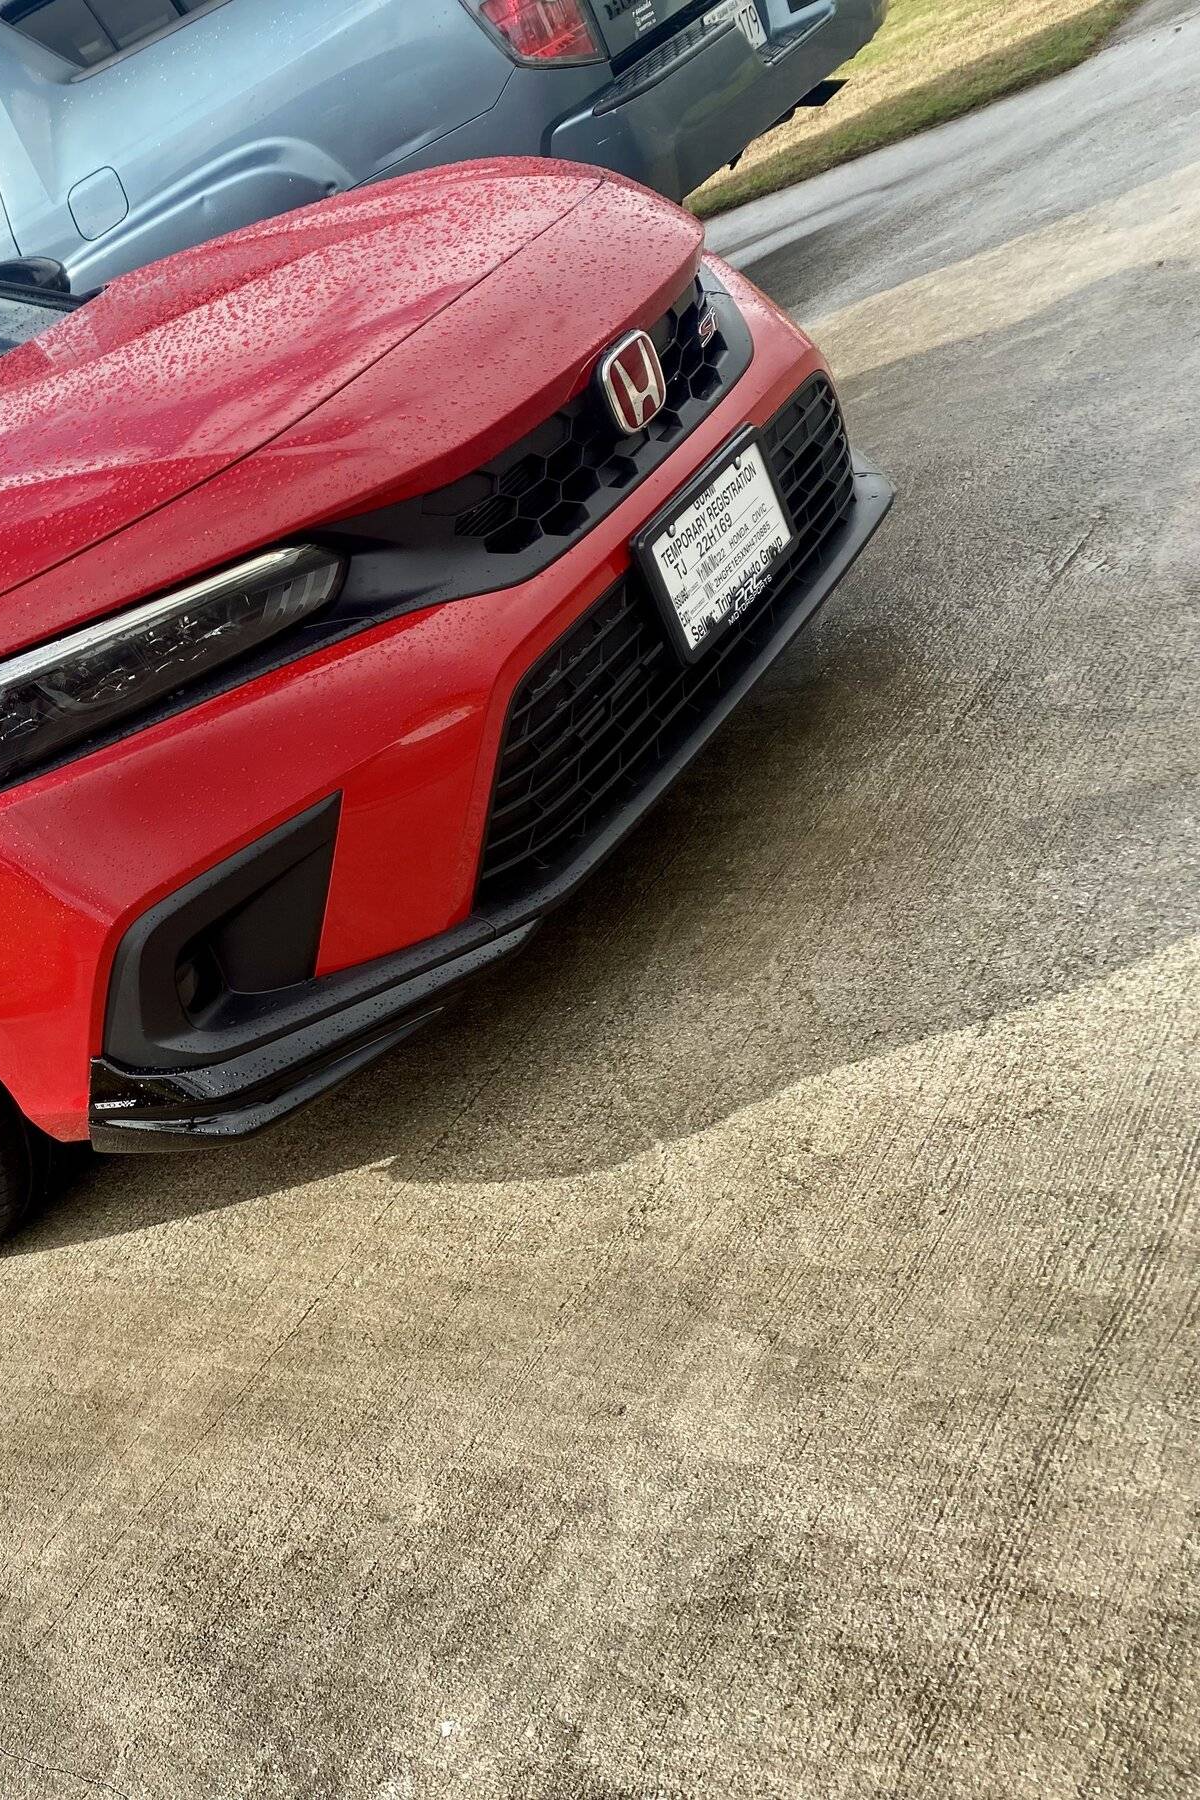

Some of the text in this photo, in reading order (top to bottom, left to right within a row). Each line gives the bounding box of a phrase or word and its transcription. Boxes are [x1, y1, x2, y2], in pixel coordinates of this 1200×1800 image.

[661, 512, 708, 568] TEMPORARY
[706, 461, 757, 522] REGISTRATION
[729, 524, 749, 548] HONDA
[752, 503, 767, 523] CIVIC
[673, 558, 688, 579] TJ
[696, 512, 733, 559] 22H169
[728, 574, 772, 626] MOTORSPORTS
